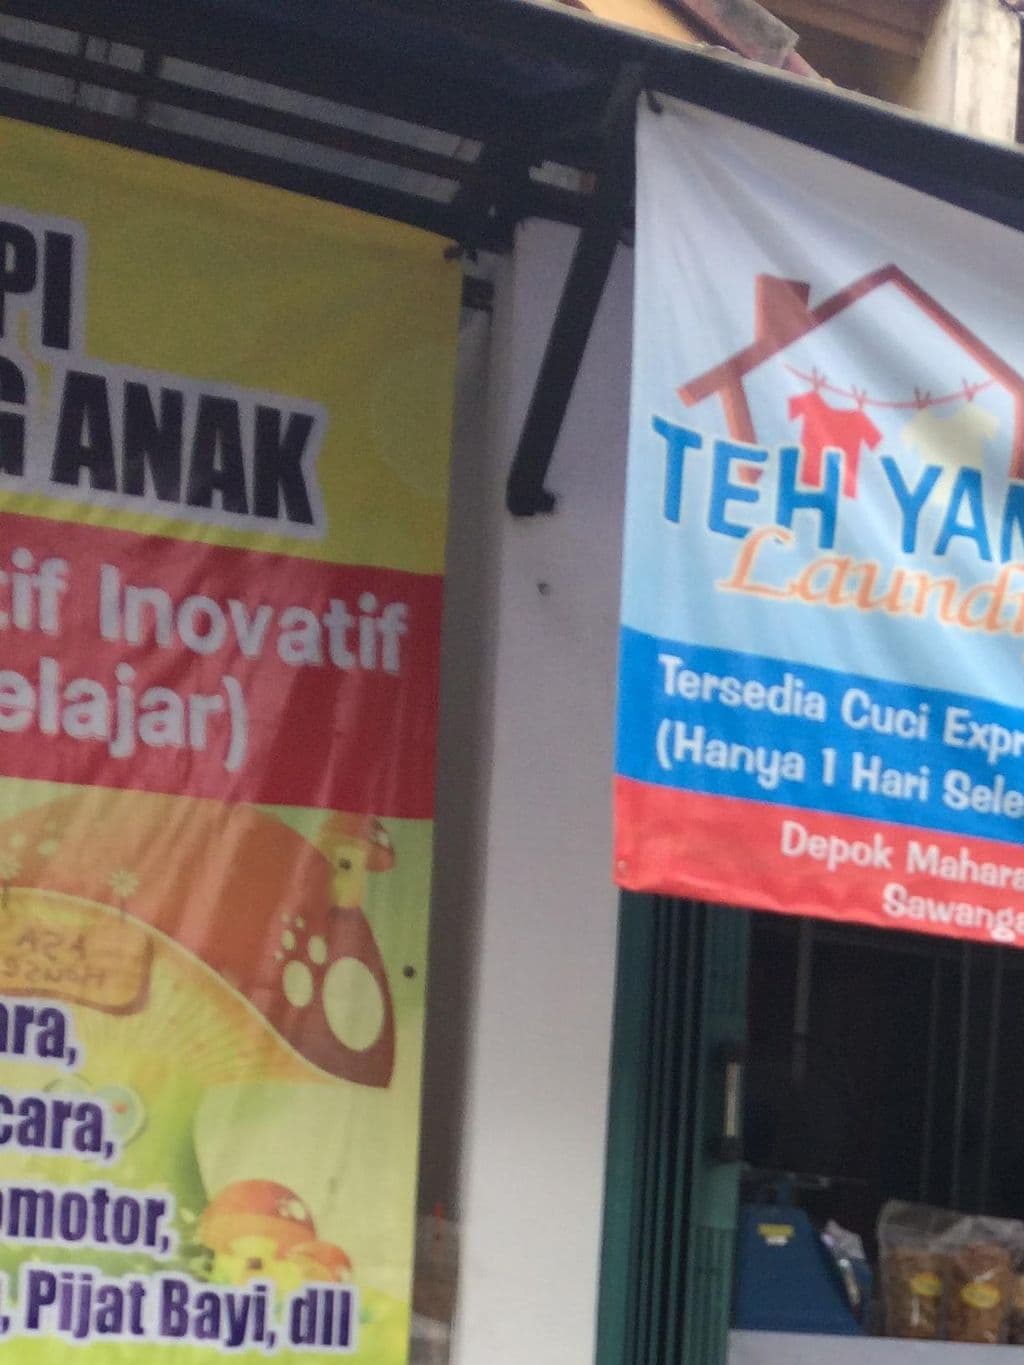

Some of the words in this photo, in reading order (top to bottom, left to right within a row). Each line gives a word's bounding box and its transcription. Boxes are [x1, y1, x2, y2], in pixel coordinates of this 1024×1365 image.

[50, 369, 316, 526] ANAK
[651, 415, 842, 550] TEH
[100, 563, 408, 676] Inovatif
[657, 652, 827, 723] Tersedia
[840, 687, 930, 740] Cuci
[655, 717, 807, 790] (Hanya
[821, 747, 838, 787] 1
[851, 751, 930, 802] Hari
[780, 819, 894, 872] Depok
[0, 1187, 170, 1253] motor,
[25, 1269, 146, 1339] Pijat
[288, 1287, 353, 1347] dll
